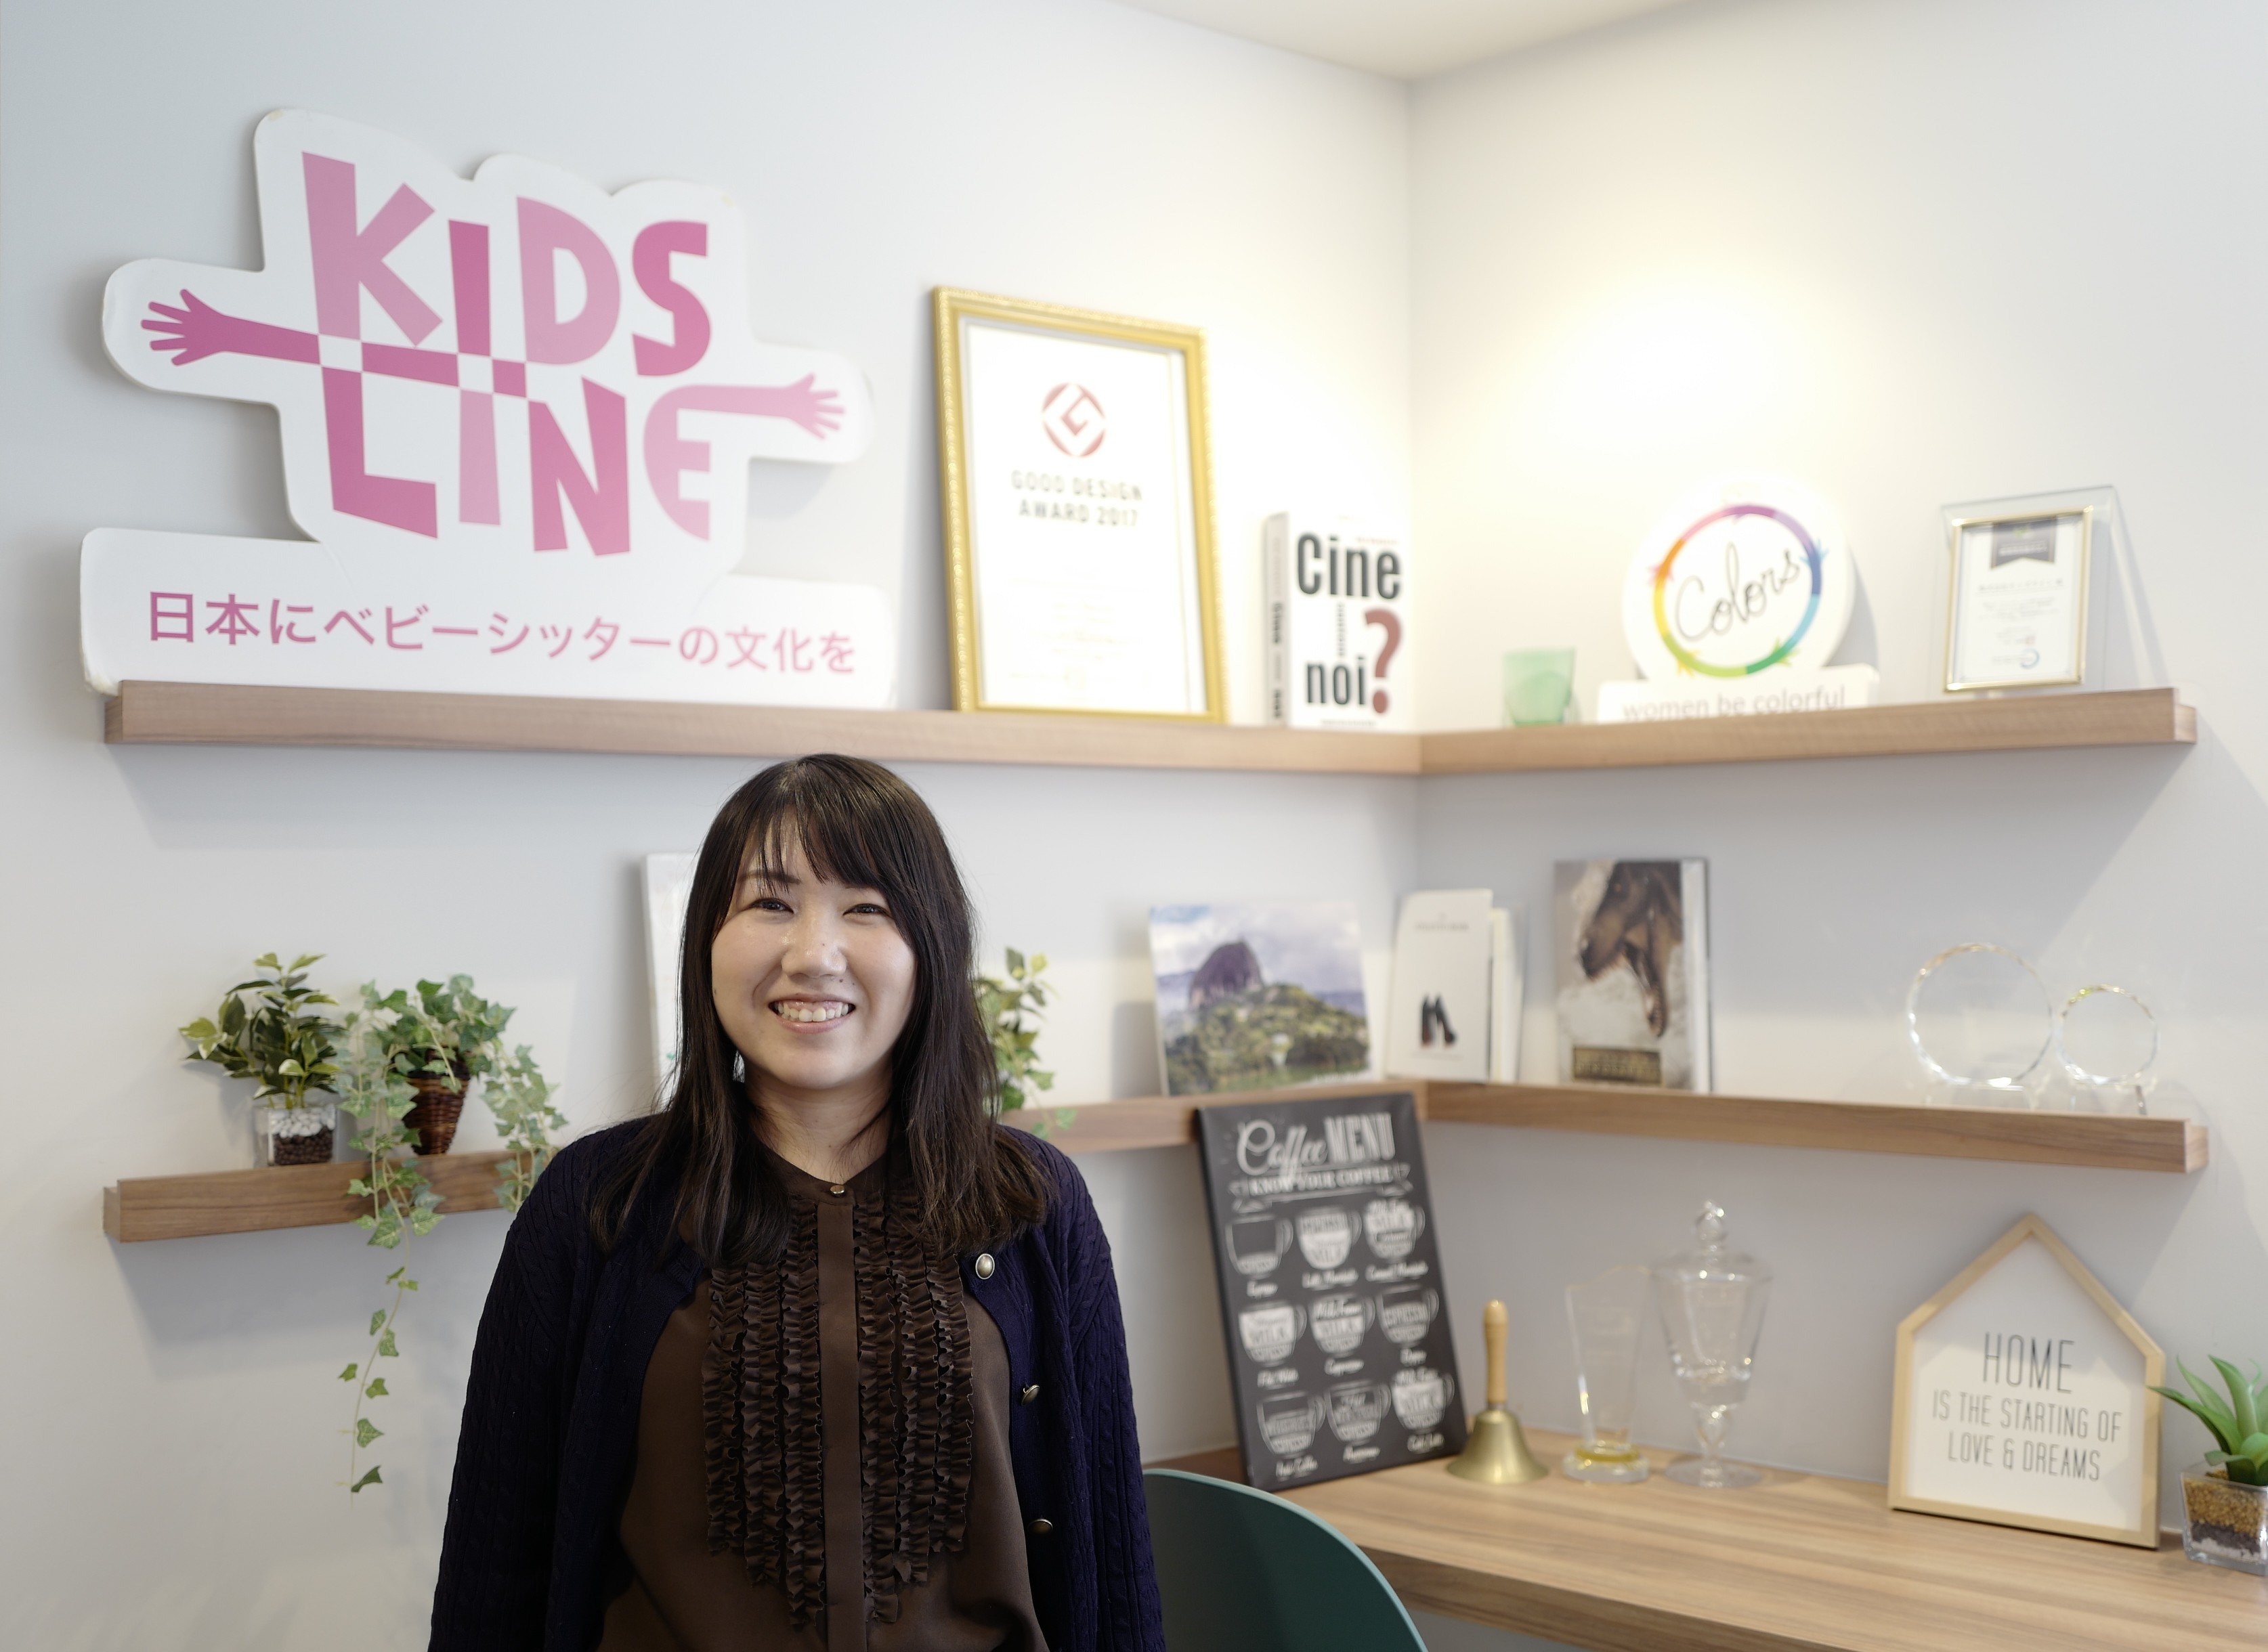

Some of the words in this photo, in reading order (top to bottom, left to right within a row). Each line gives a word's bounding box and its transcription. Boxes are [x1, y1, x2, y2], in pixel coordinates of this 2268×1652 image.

[302, 151, 712, 377] KIDS
[321, 376, 712, 557] LINE
[1011, 471, 1065, 494] GOOD
[1072, 477, 1142, 501] DESIGN
[1019, 499, 1090, 523] AWARD
[1097, 506, 1138, 527] 2017
[1297, 532, 1400, 599] Cine
[1675, 542, 1801, 642] Colors
[149, 592, 855, 676] 日本にベビーシッターの文化を
[1623, 695, 1709, 722] women
[1718, 693, 1746, 717] be
[1753, 684, 1846, 714] colorful
[1237, 1119, 1328, 1182] Coffee
[1324, 1112, 1395, 1162] MENU
[1983, 1332, 2075, 1394] HOME
[1933, 1389, 1950, 1421] IS
[1959, 1392, 1992, 1427] THE
[2000, 1397, 2089, 1439] STARTING
[2097, 1410, 2122, 1443] OF
[1948, 1431, 1994, 1466] LOVE
[2003, 1438, 2015, 1471] &
[2023, 1440, 2101, 1481] DREAMS
